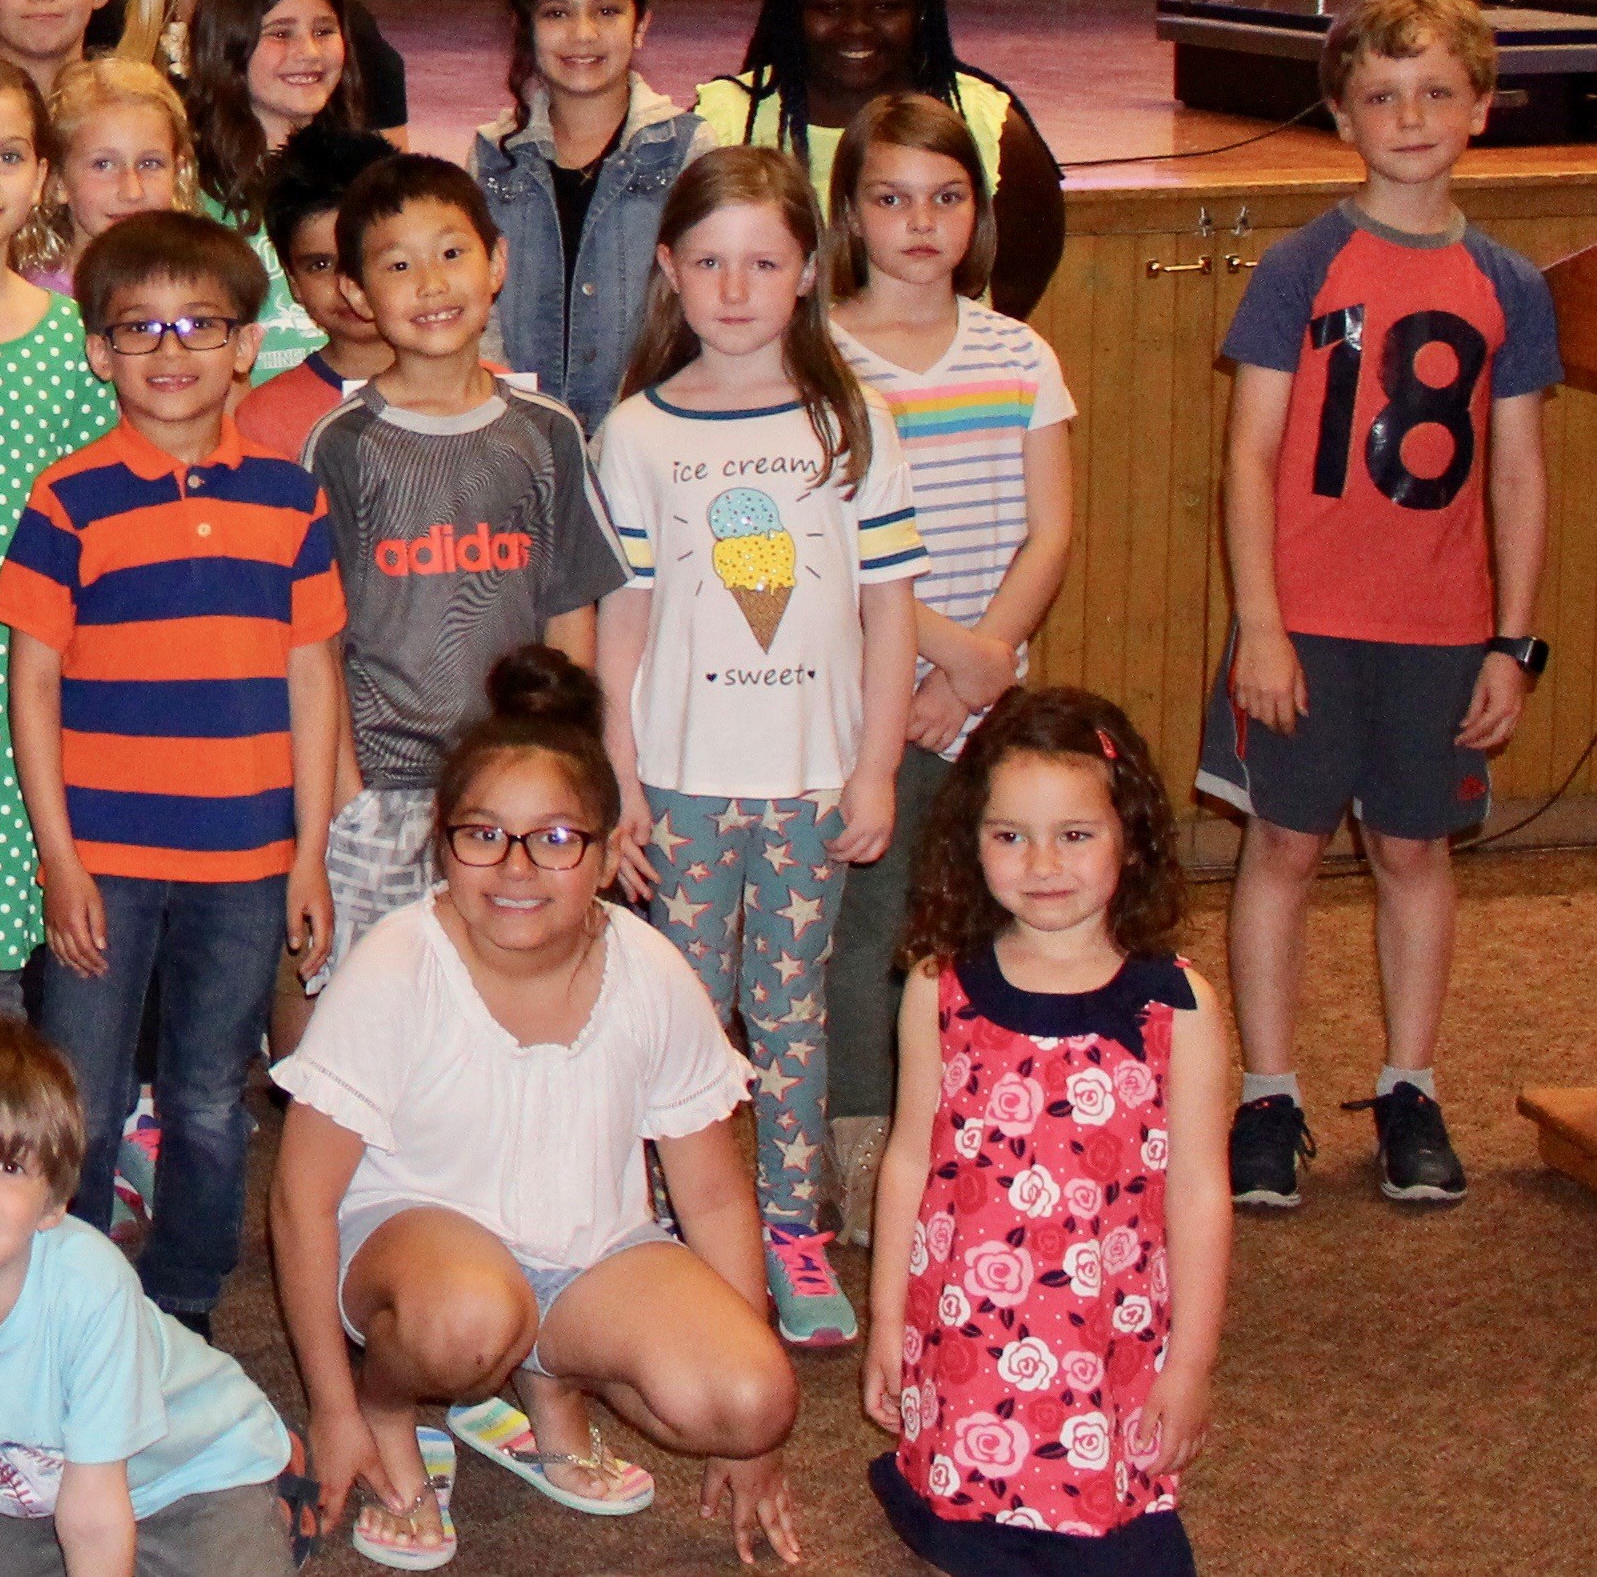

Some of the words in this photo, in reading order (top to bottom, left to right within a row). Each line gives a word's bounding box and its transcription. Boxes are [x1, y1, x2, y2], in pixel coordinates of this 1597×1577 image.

[1310, 303, 1487, 511] 18
[673, 460, 708, 483] ice
[723, 456, 819, 477] cream
[374, 522, 533, 577] adidas
[723, 663, 805, 686] sweet
